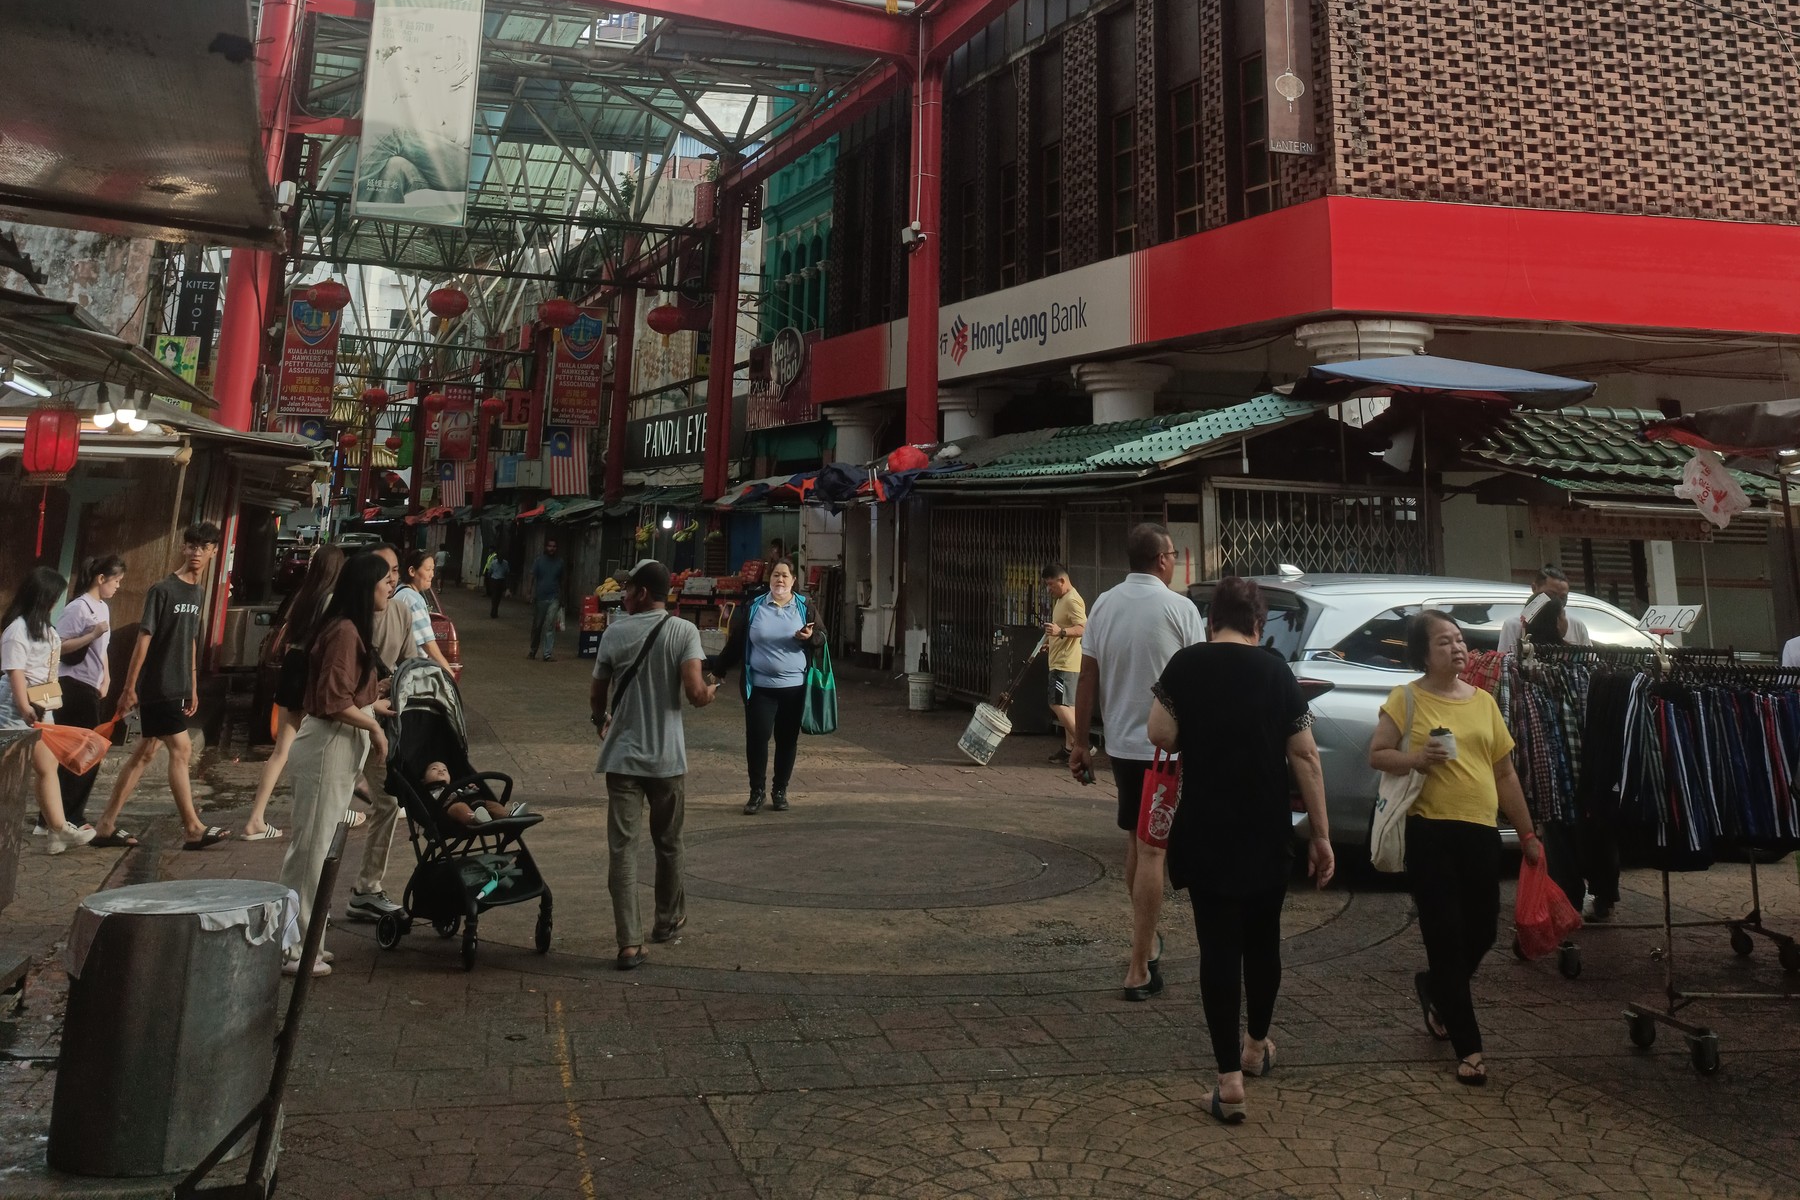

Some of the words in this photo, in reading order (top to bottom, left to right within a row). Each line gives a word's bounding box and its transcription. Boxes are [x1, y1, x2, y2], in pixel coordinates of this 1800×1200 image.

[1270, 140, 1313, 152] LANTERN
[186, 281, 215, 290] KITEZ
[1052, 297, 1088, 334] Bank
[774, 333, 790, 362] Hari
[780, 353, 798, 384] Hari
[644, 416, 680, 458] PANDA
[1670, 608, 1696, 629] 10
